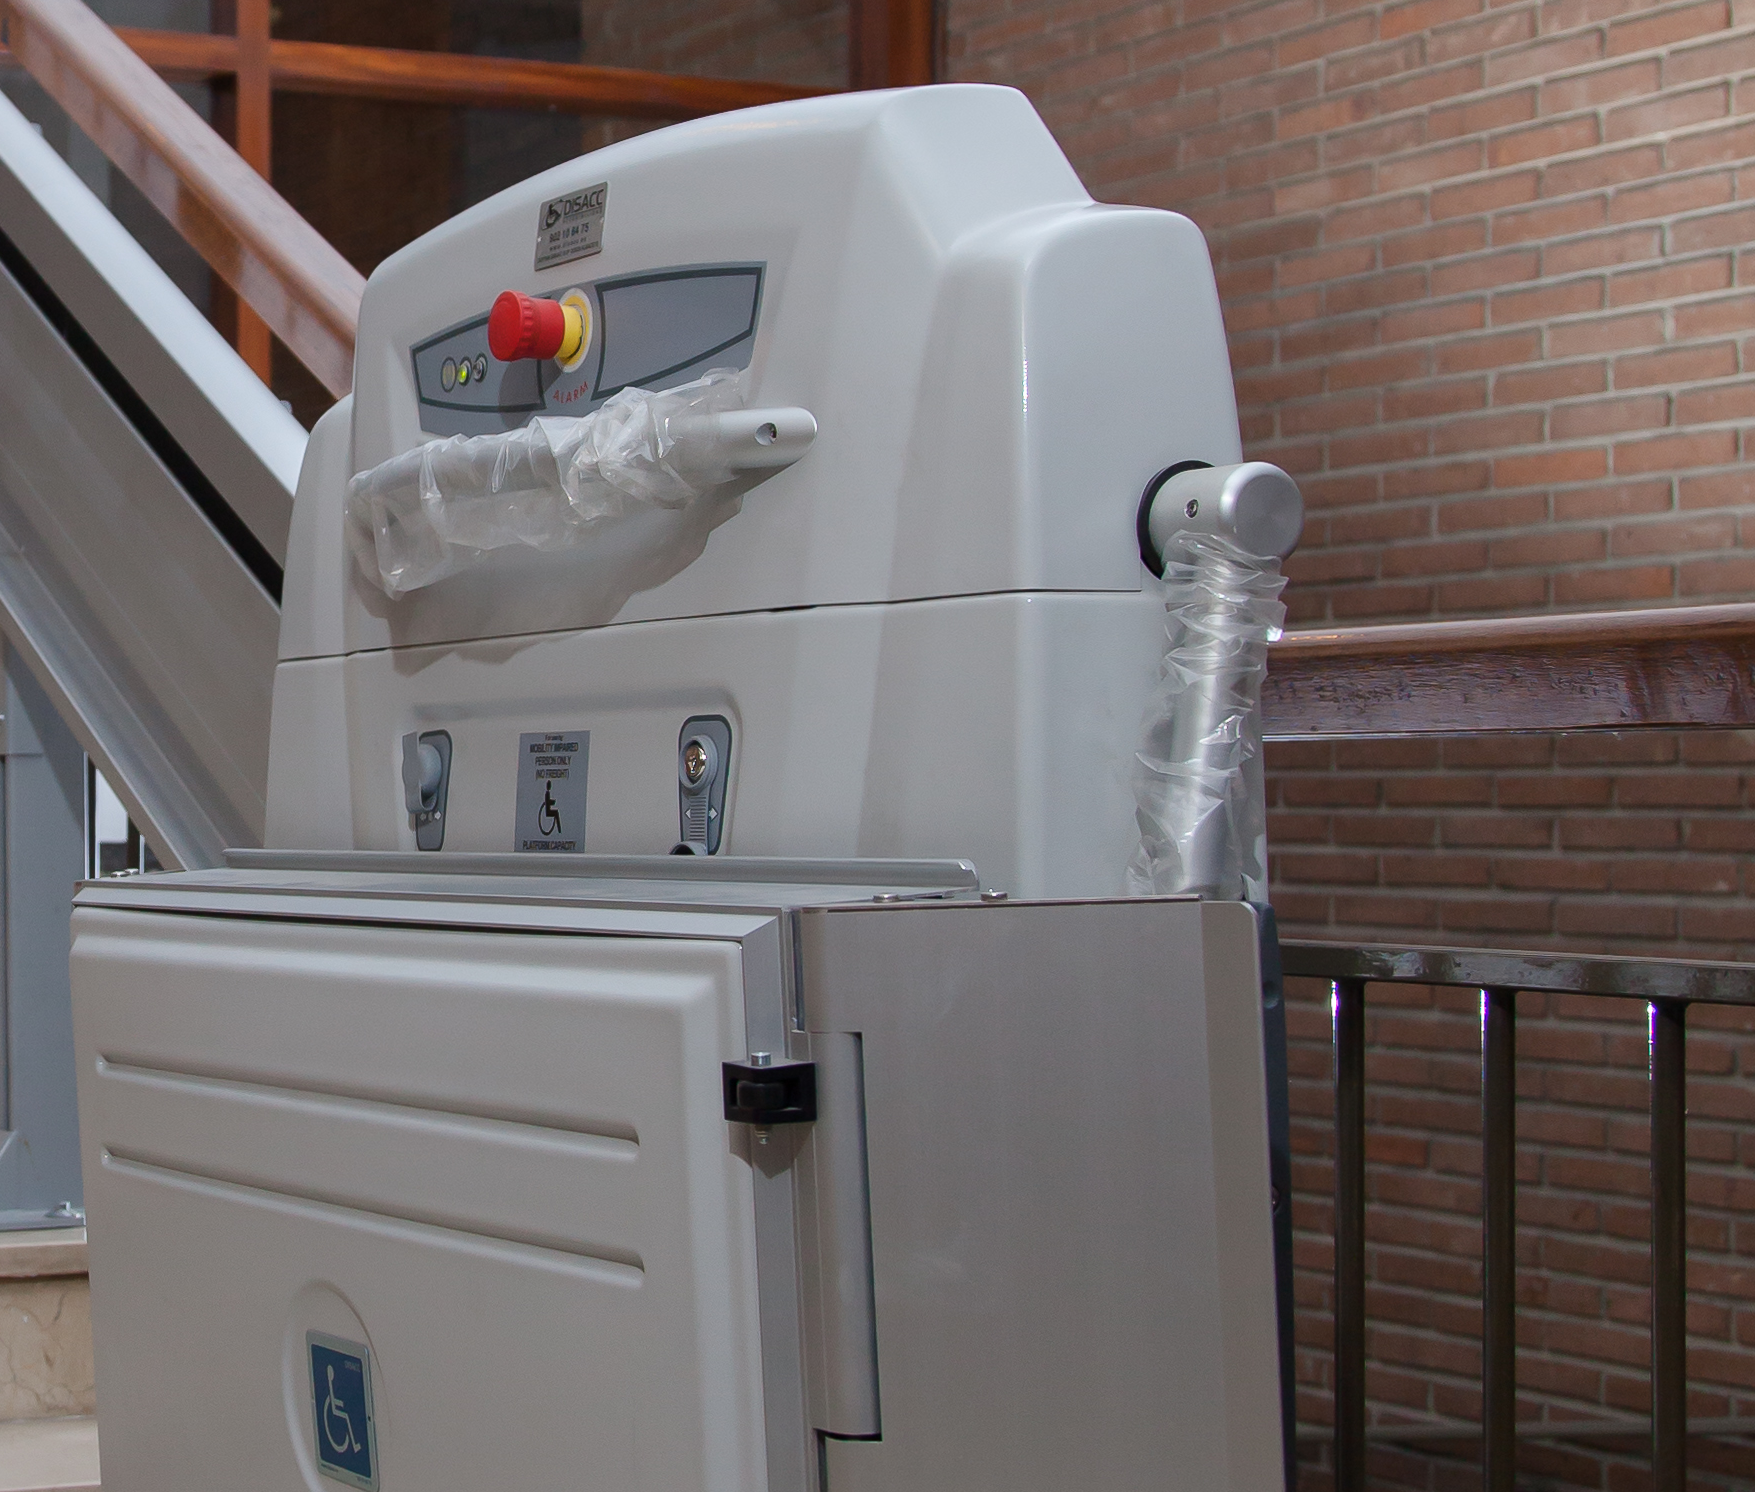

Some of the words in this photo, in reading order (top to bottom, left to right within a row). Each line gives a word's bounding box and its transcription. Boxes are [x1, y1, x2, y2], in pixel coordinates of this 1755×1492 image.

[564, 189, 604, 215] DISACC
[552, 381, 589, 404] ALARM
[530, 743, 553, 753] MOBILITY
[554, 742, 578, 752] IMPAIRED
[535, 756, 556, 766] PERSON
[556, 755, 572, 766] ONLY
[523, 839, 551, 850] PLATFORM
[551, 840, 577, 850] CAPACITY
